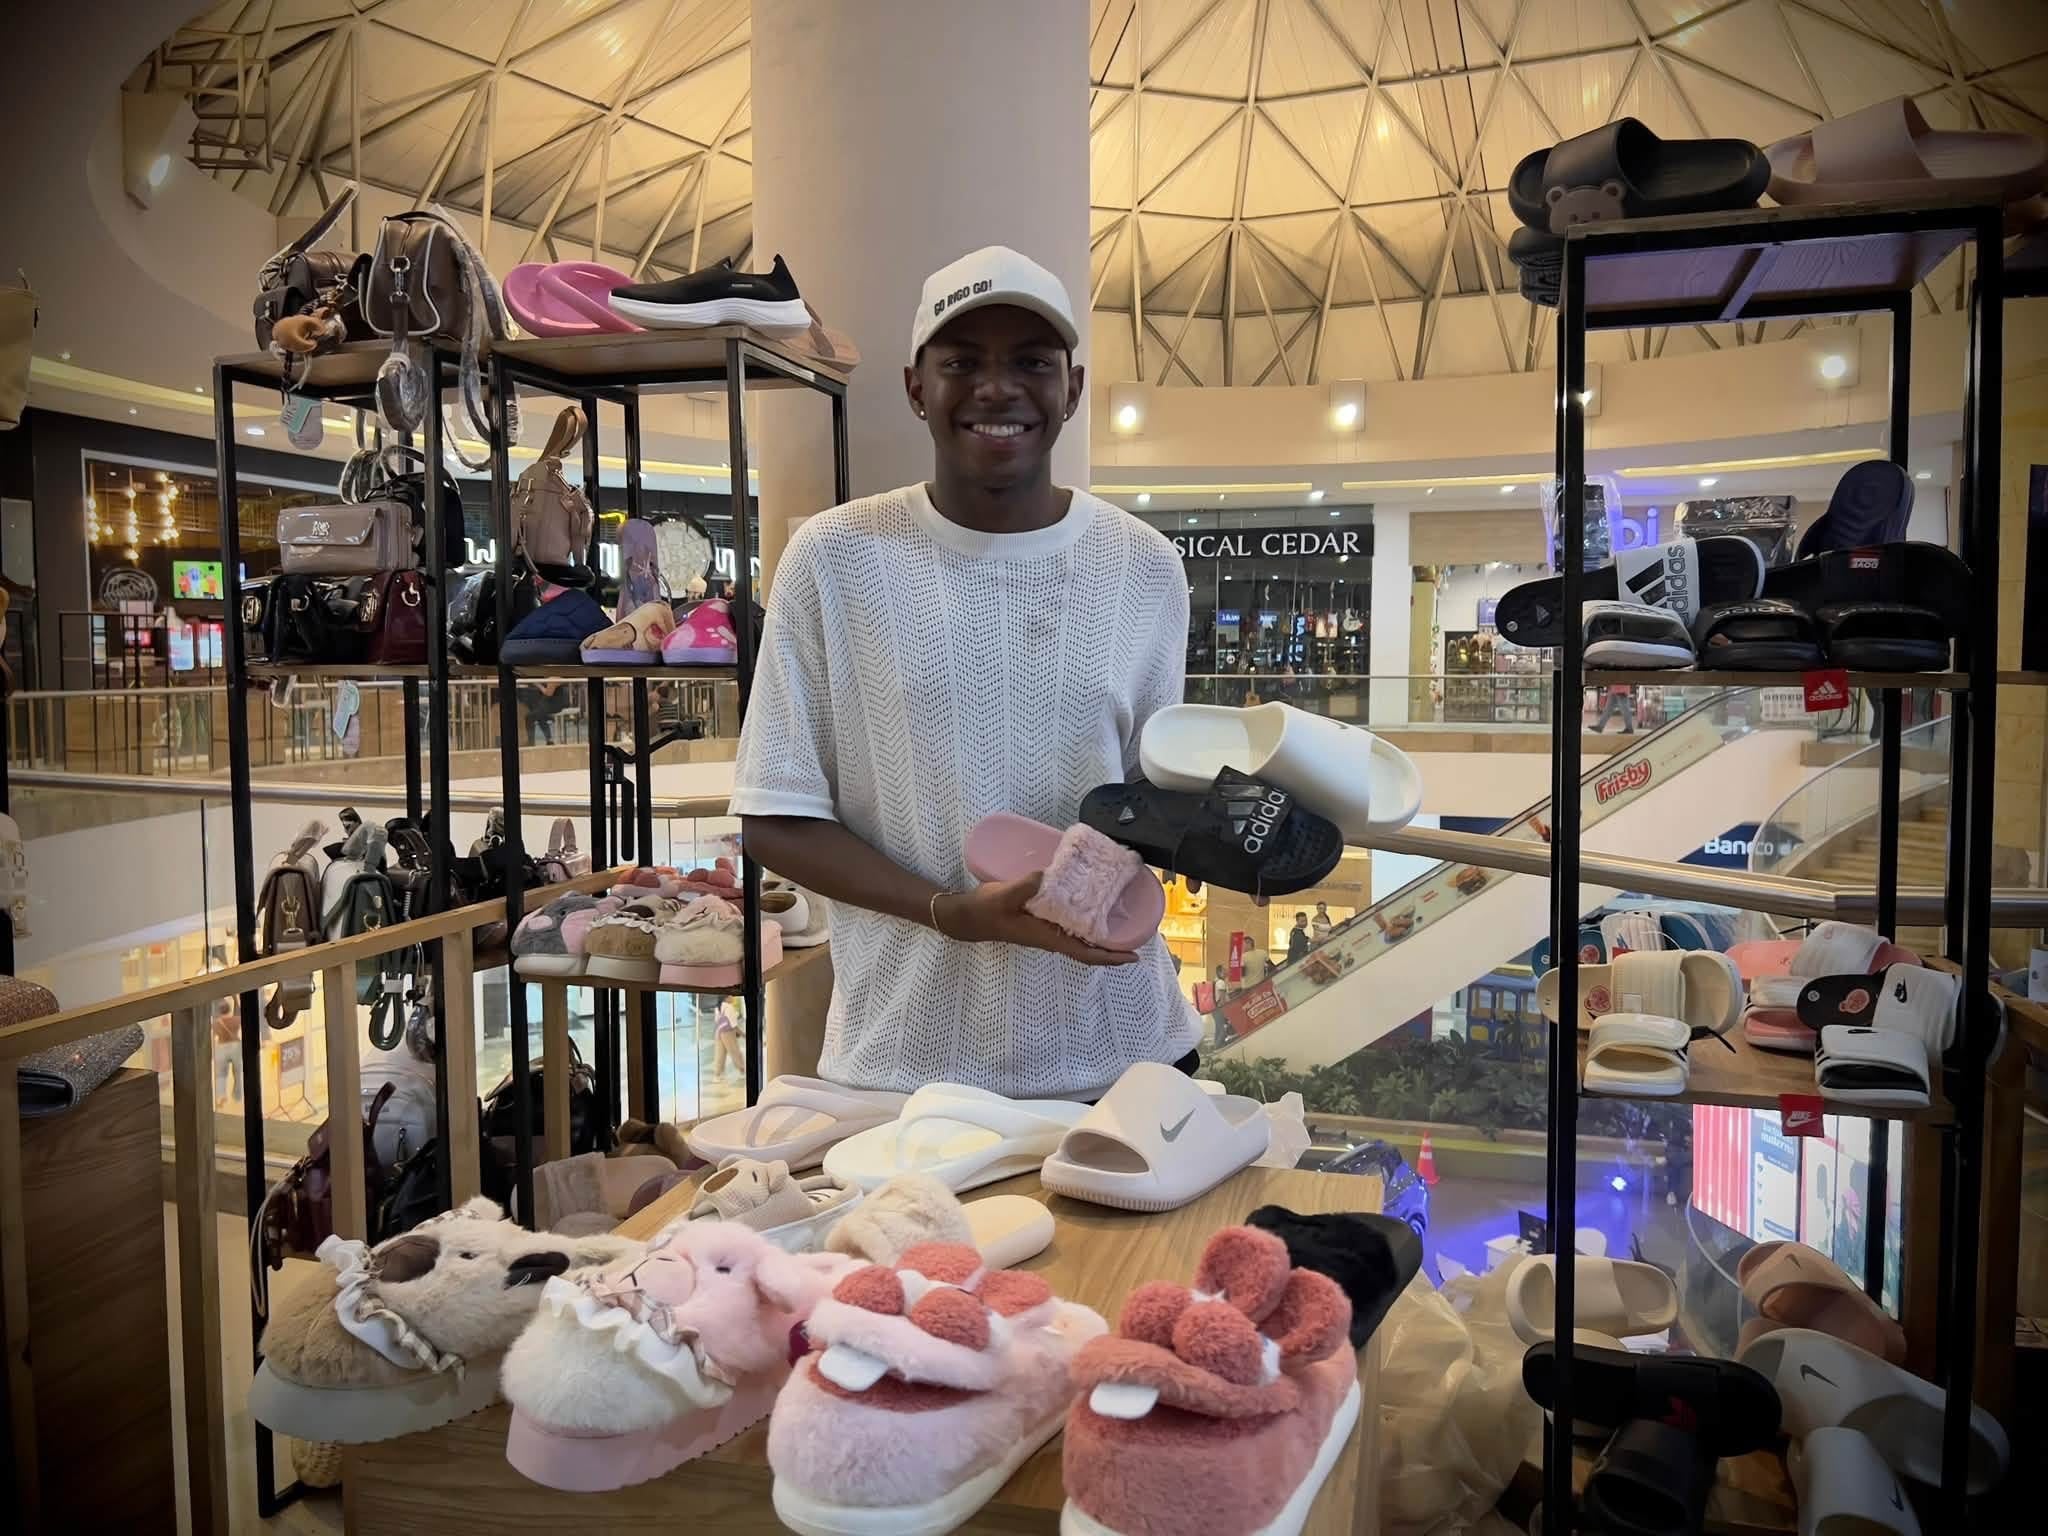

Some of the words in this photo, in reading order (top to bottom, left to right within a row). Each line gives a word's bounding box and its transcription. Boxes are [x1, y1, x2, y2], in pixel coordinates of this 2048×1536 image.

[934, 299, 945, 316] GO
[947, 286, 970, 307] RIGO
[973, 279, 992, 294] GO!
[1261, 532, 1360, 555] CEDAR
[1596, 760, 1651, 803] Frisby
[1243, 788, 1288, 853] adida
[1704, 837, 1774, 855] Banco
